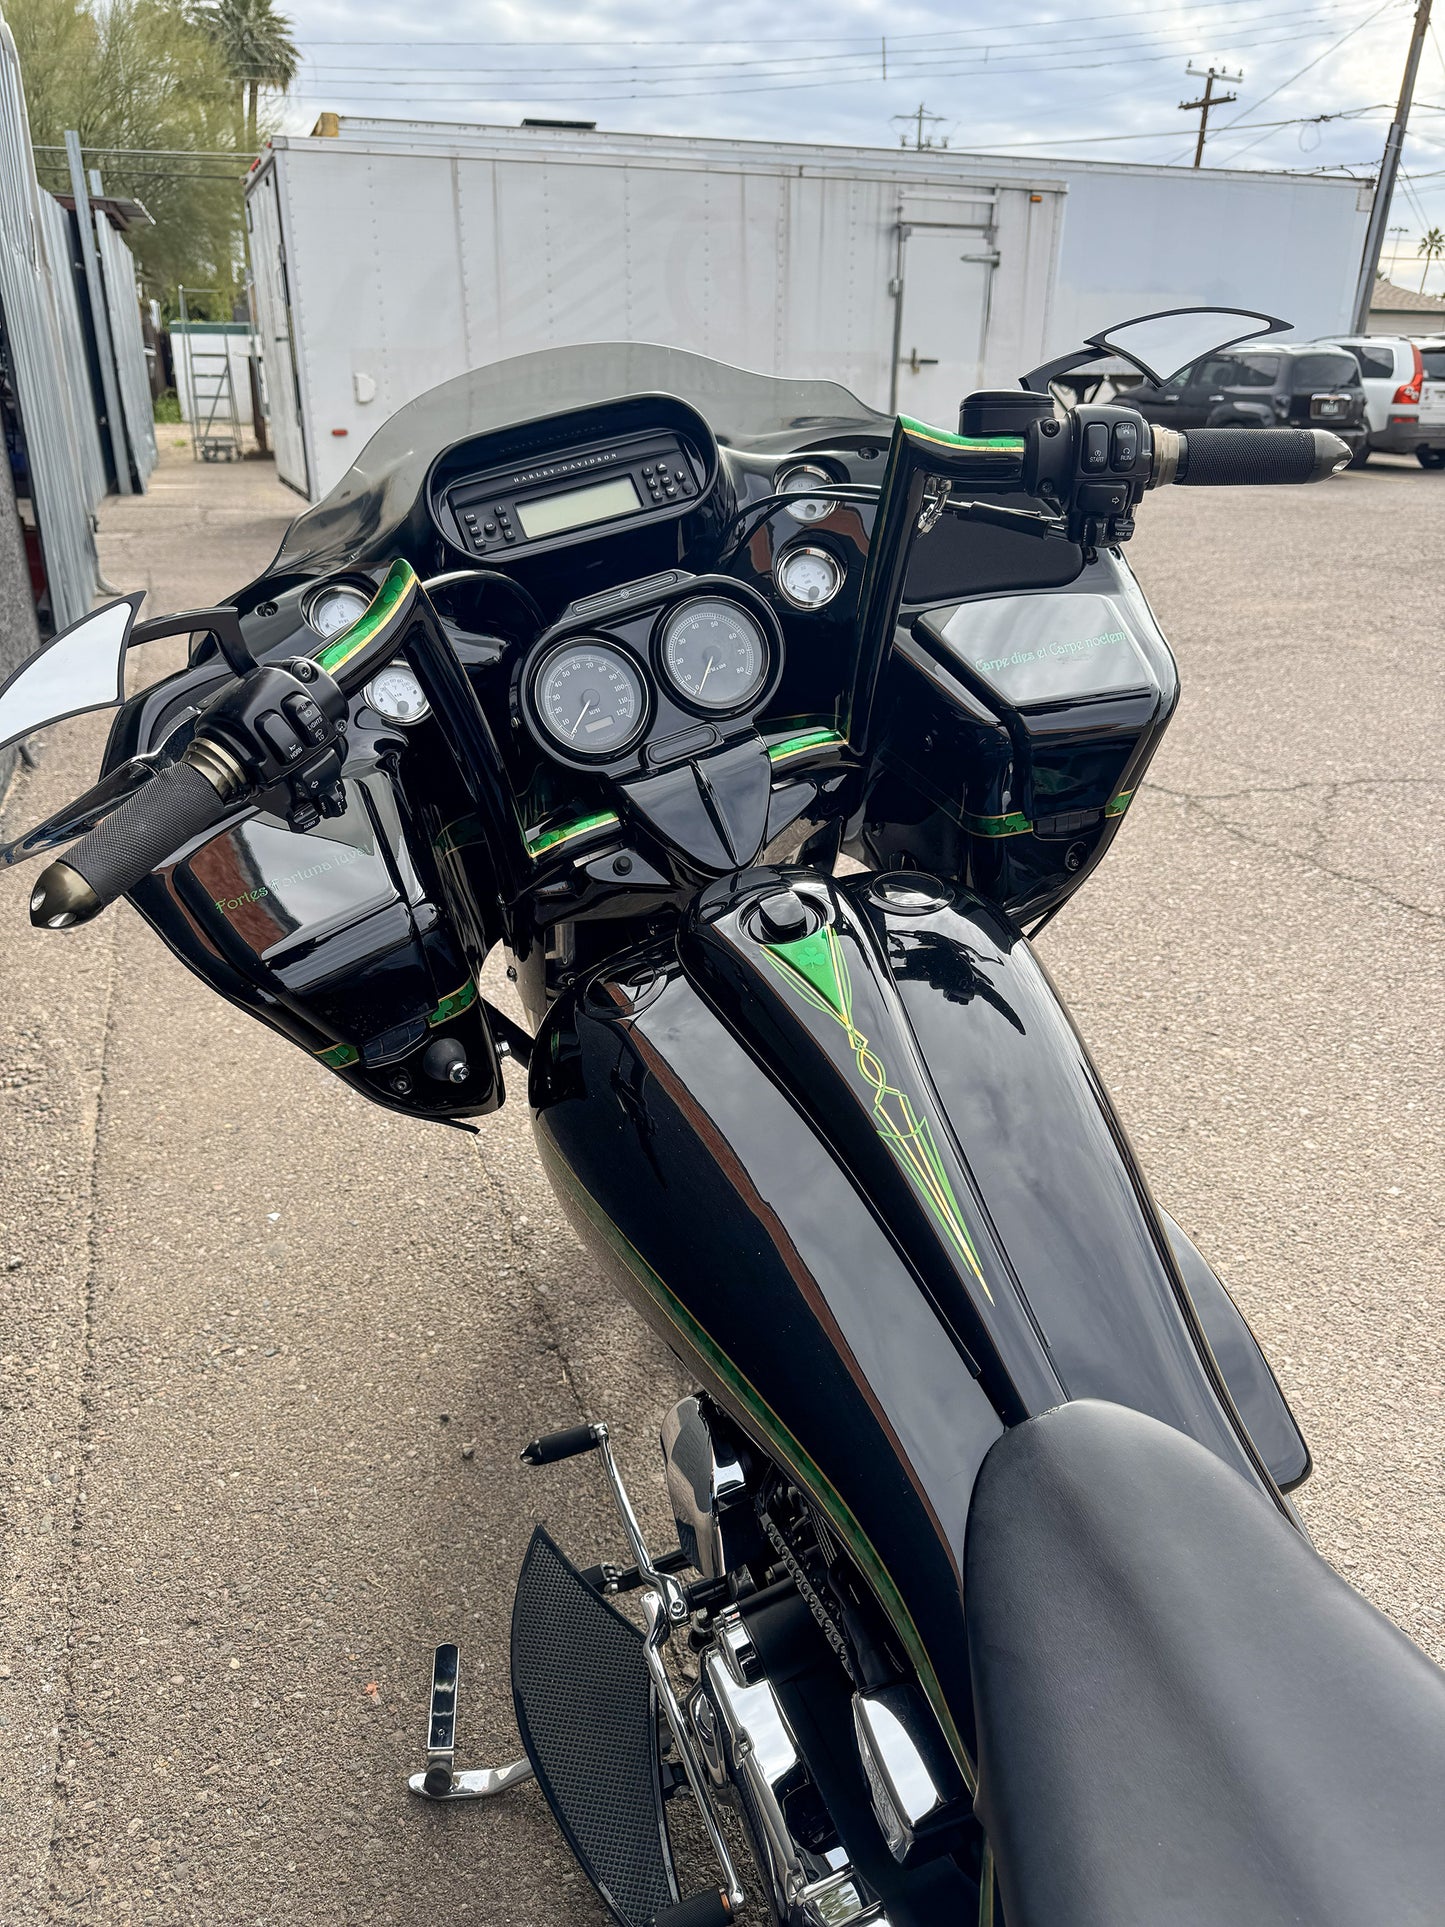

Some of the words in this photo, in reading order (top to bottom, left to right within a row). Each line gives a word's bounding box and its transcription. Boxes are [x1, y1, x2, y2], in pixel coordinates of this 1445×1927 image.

[513, 453, 617, 482] HARLEY-DAVIDSON
[691, 622, 699, 630] 40
[728, 632, 737, 640] 60
[975, 656, 1009, 673] Carpe
[1010, 650, 1035, 665] dies
[1049, 640, 1083, 656] Carpe
[585, 661, 594, 669] 70
[675, 657, 684, 665] 20
[572, 663, 581, 671] 60
[598, 665, 607, 673] 80
[736, 666, 745, 674] 80
[608, 673, 618, 681] 90
[684, 673, 692, 681] 10
[554, 680, 563, 688] 40
[614, 683, 625, 692] 100
[618, 696, 628, 705] 110
[554, 706, 563, 714] 20
[588, 708, 601, 716] MPH
[616, 708, 627, 716] 120
[307, 715, 323, 731] LIGHTS
[561, 718, 570, 726] 10
[290, 746, 303, 759] HORN
[215, 885, 269, 914] Fortes
[270, 862, 331, 892] Fortuna
